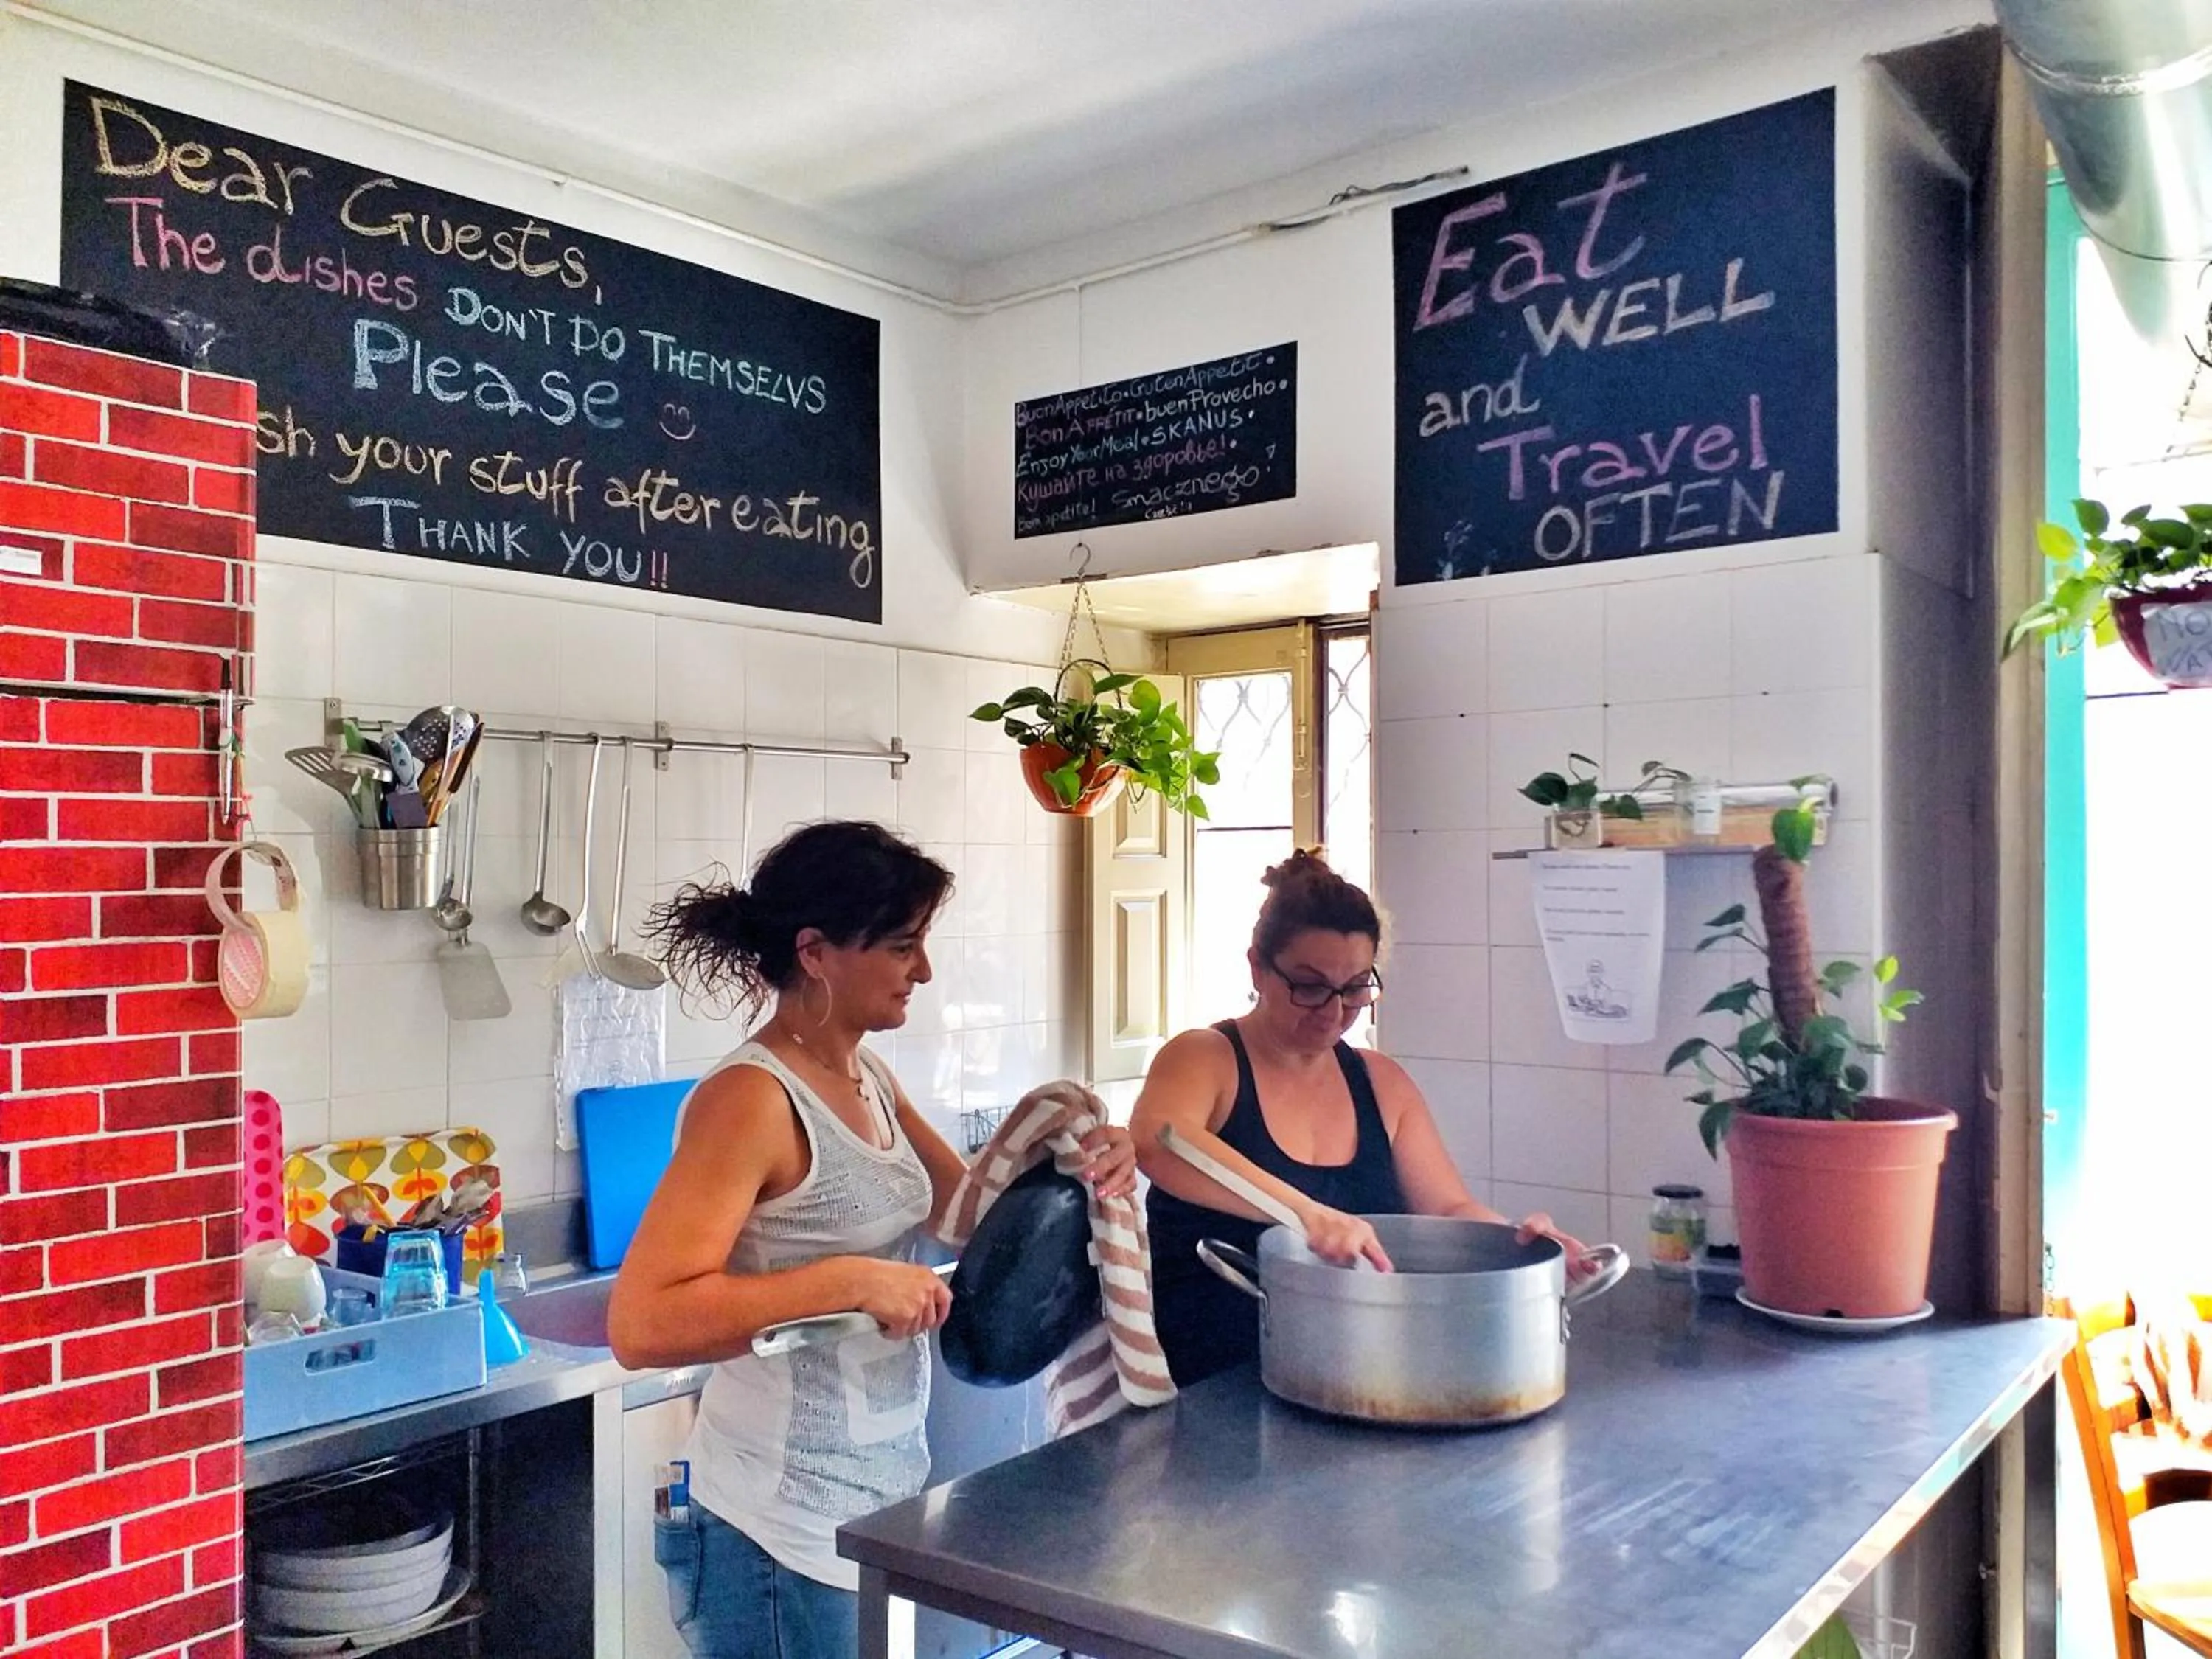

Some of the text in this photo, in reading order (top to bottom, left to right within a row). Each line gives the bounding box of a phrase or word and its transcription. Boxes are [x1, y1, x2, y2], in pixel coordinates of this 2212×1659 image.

[89, 96, 313, 215] Dear
[105, 196, 225, 274] The
[247, 221, 418, 310] dishes
[445, 287, 556, 345] DON'T
[568, 313, 625, 364] DO
[1413, 162, 1647, 332] Eat
[1522, 257, 1775, 357] WELL
[351, 317, 624, 429] Please
[1419, 353, 1540, 437] and
[257, 404, 876, 588] sh your stuff after eating
[1477, 393, 1768, 501] Travel
[348, 495, 668, 588] THANK YOU!!
[1534, 470, 1785, 561] OFTEN
